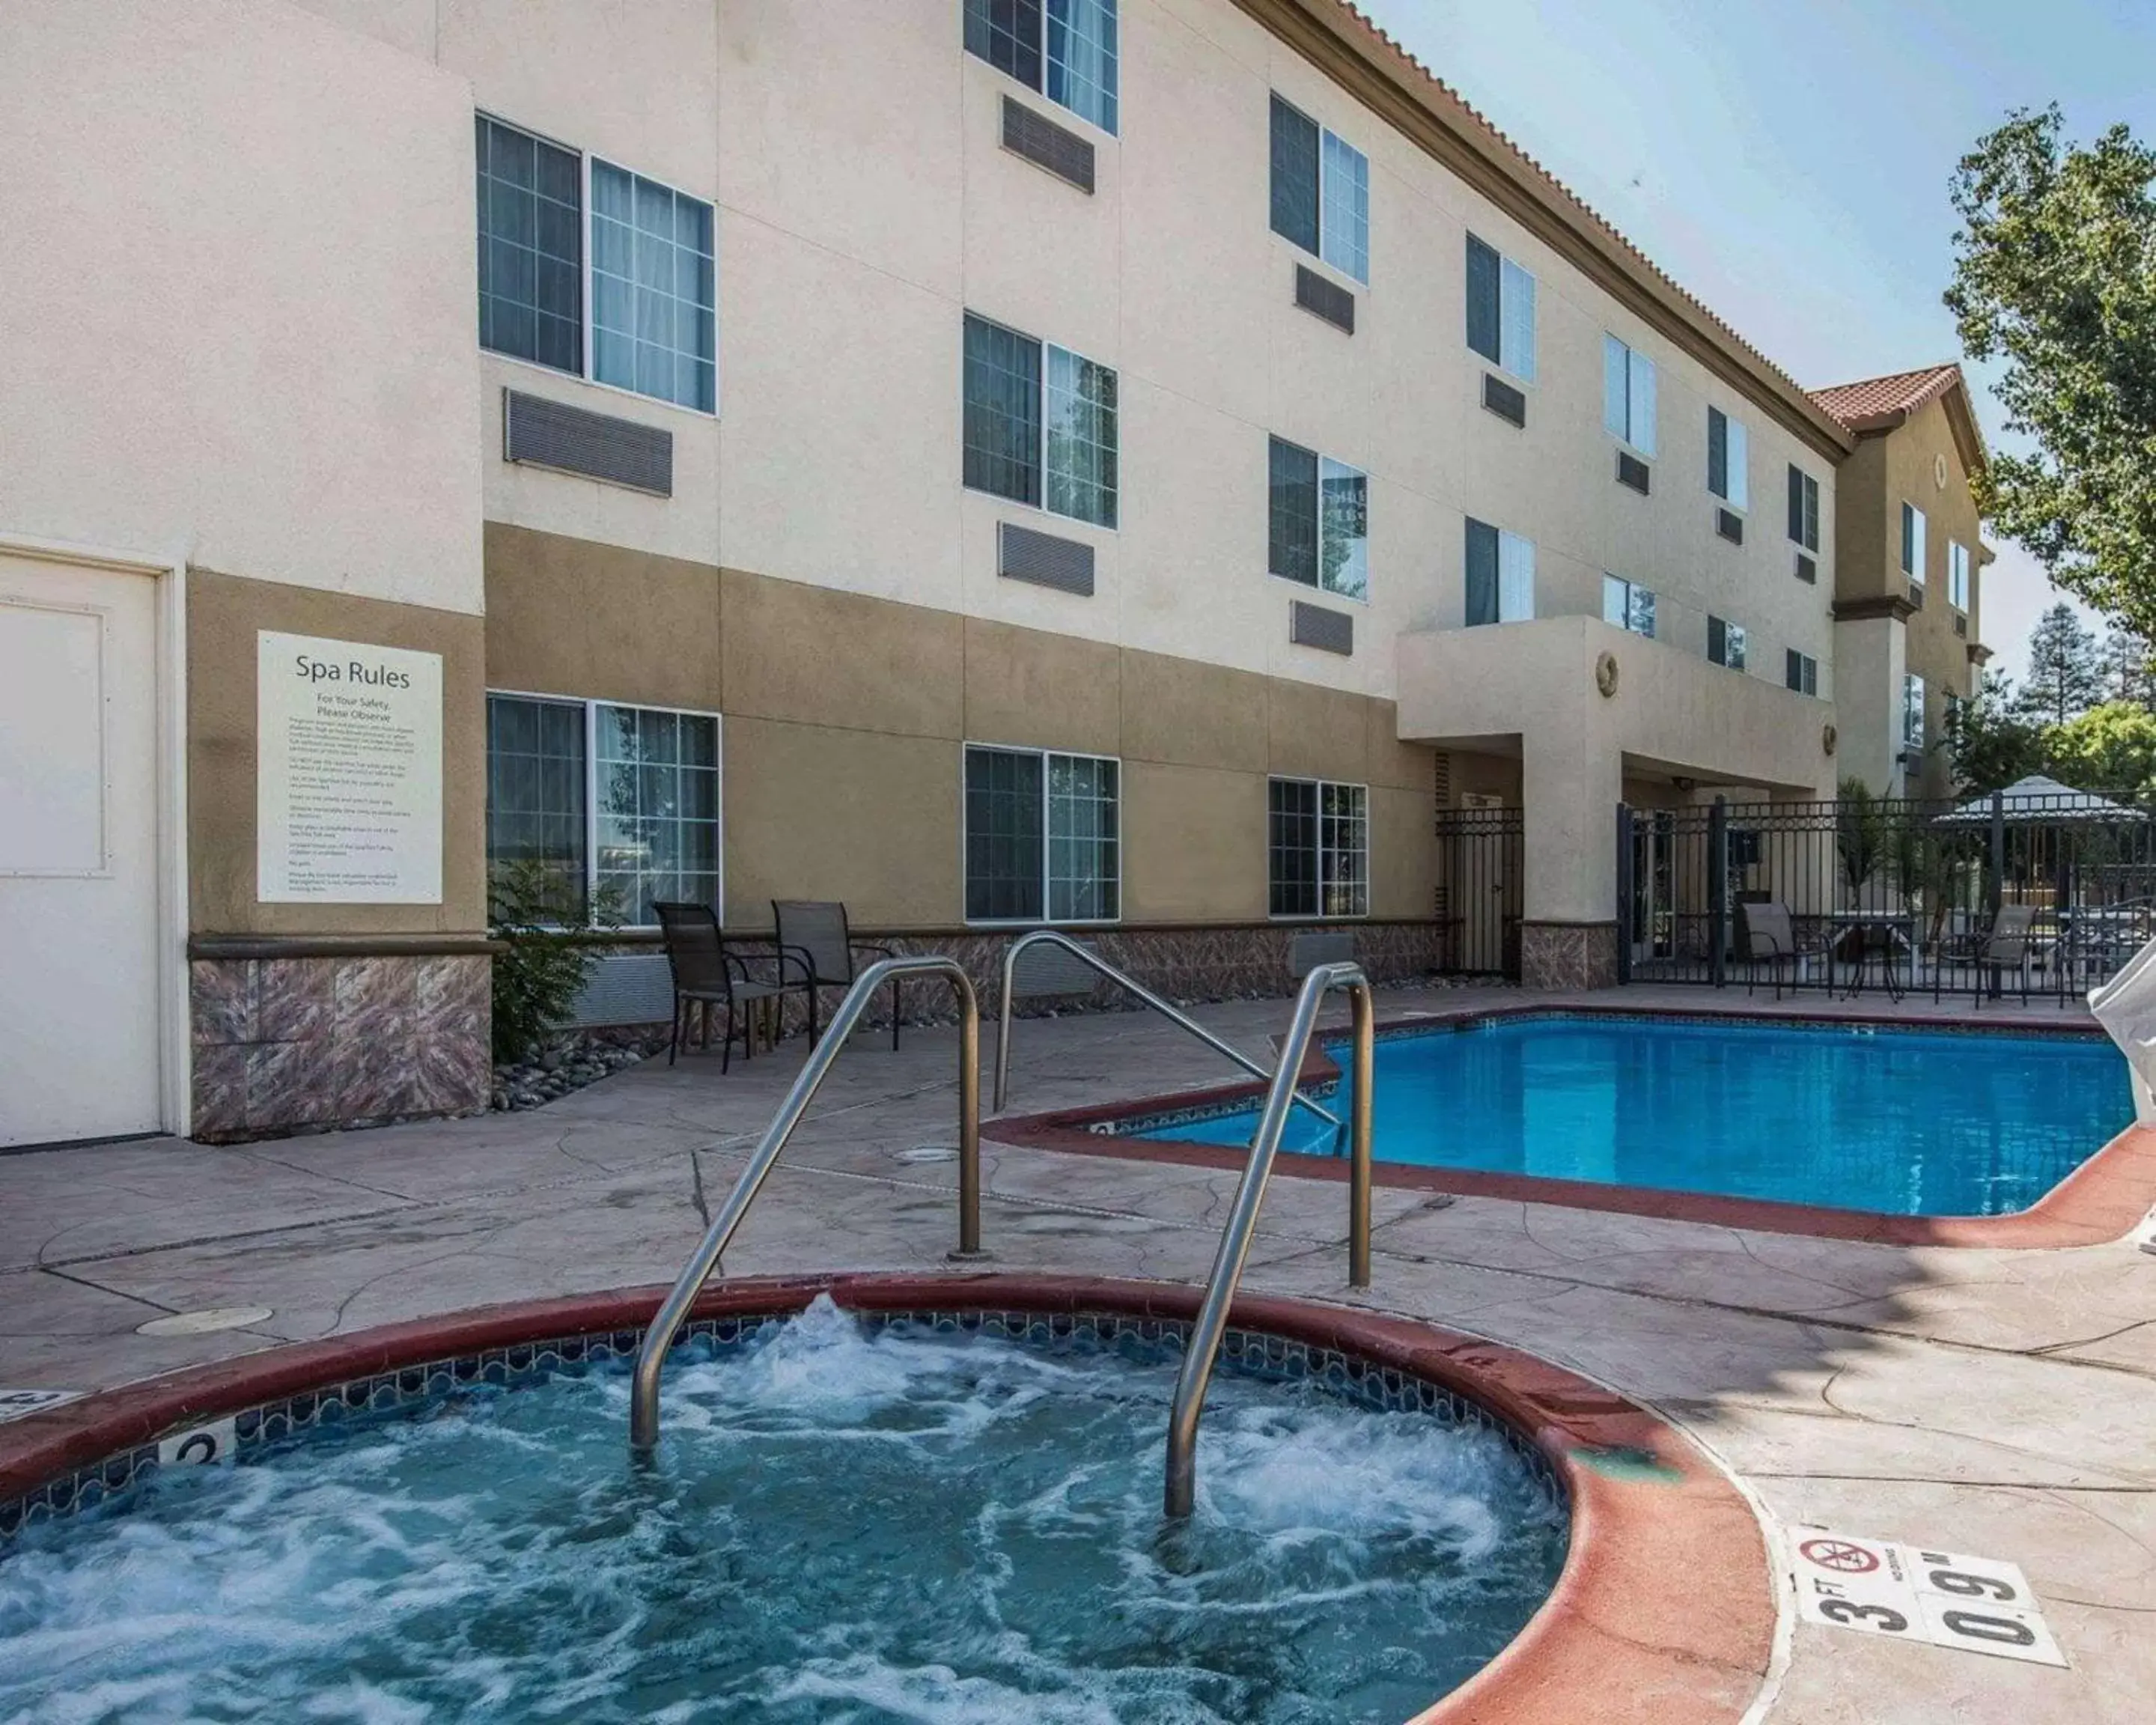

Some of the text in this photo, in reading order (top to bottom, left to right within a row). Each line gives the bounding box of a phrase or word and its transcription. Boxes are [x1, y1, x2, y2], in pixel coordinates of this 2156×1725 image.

[296, 654, 410, 689] Spa Rules
[317, 693, 332, 704] For
[317, 706, 348, 718] Please
[1814, 1578, 1908, 1632] 3 FT
